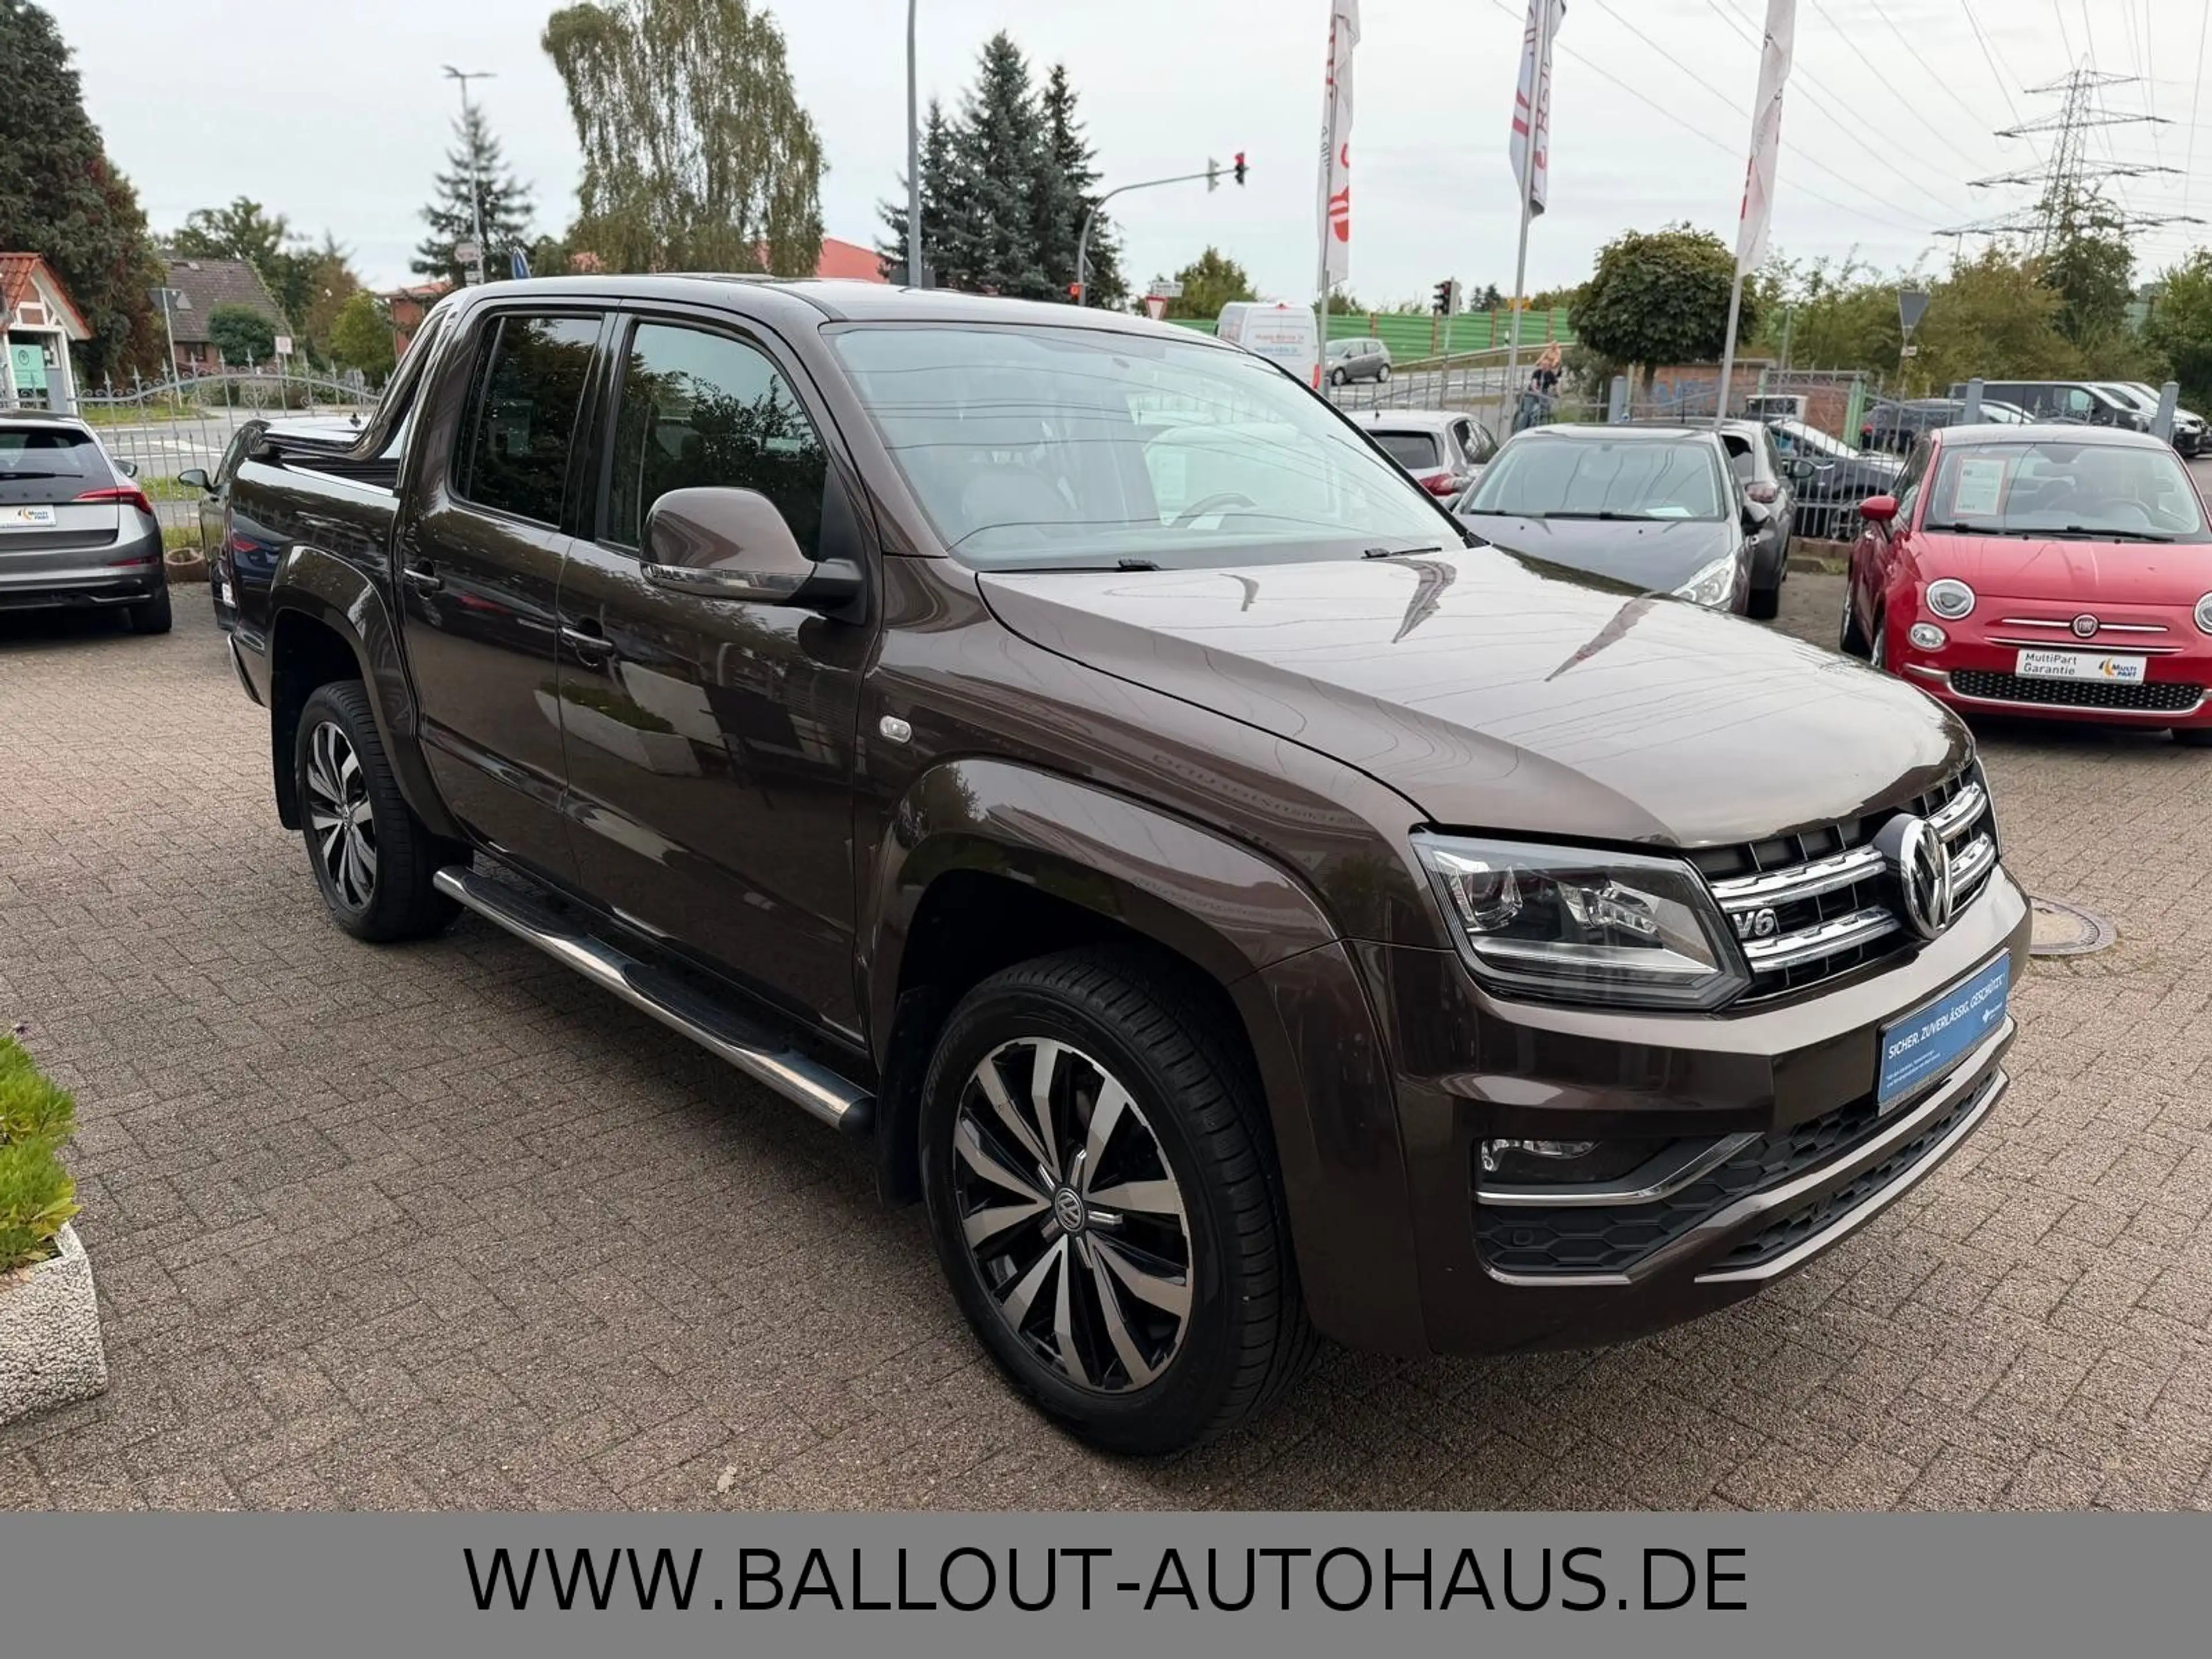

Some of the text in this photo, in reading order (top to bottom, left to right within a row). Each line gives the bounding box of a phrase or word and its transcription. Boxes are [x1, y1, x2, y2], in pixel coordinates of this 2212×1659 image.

[2024, 662, 2075, 675] Garantie
[2025, 653, 2077, 664] MultiPart
[1732, 908, 1775, 938] V6
[1888, 1032, 1921, 1060] SICHER.
